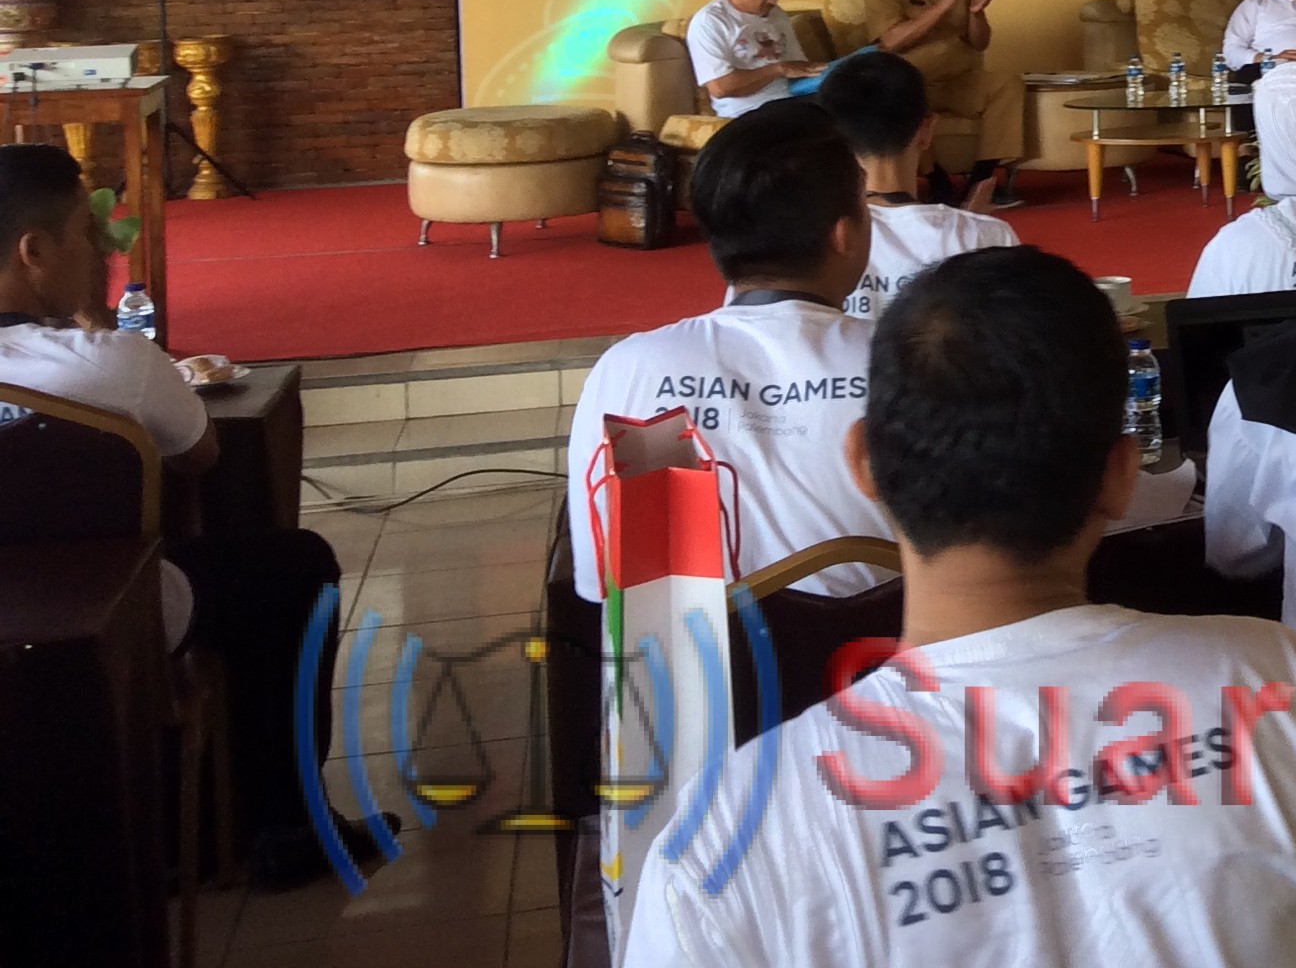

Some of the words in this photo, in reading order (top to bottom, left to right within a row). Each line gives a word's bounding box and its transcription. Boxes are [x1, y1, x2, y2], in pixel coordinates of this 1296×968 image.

[656, 375, 750, 402] ASIAN
[759, 376, 868, 407] GAMES
[881, 787, 1042, 868] ASIAN
[1056, 726, 1236, 812] GAMES
[889, 851, 1015, 927] 2018
